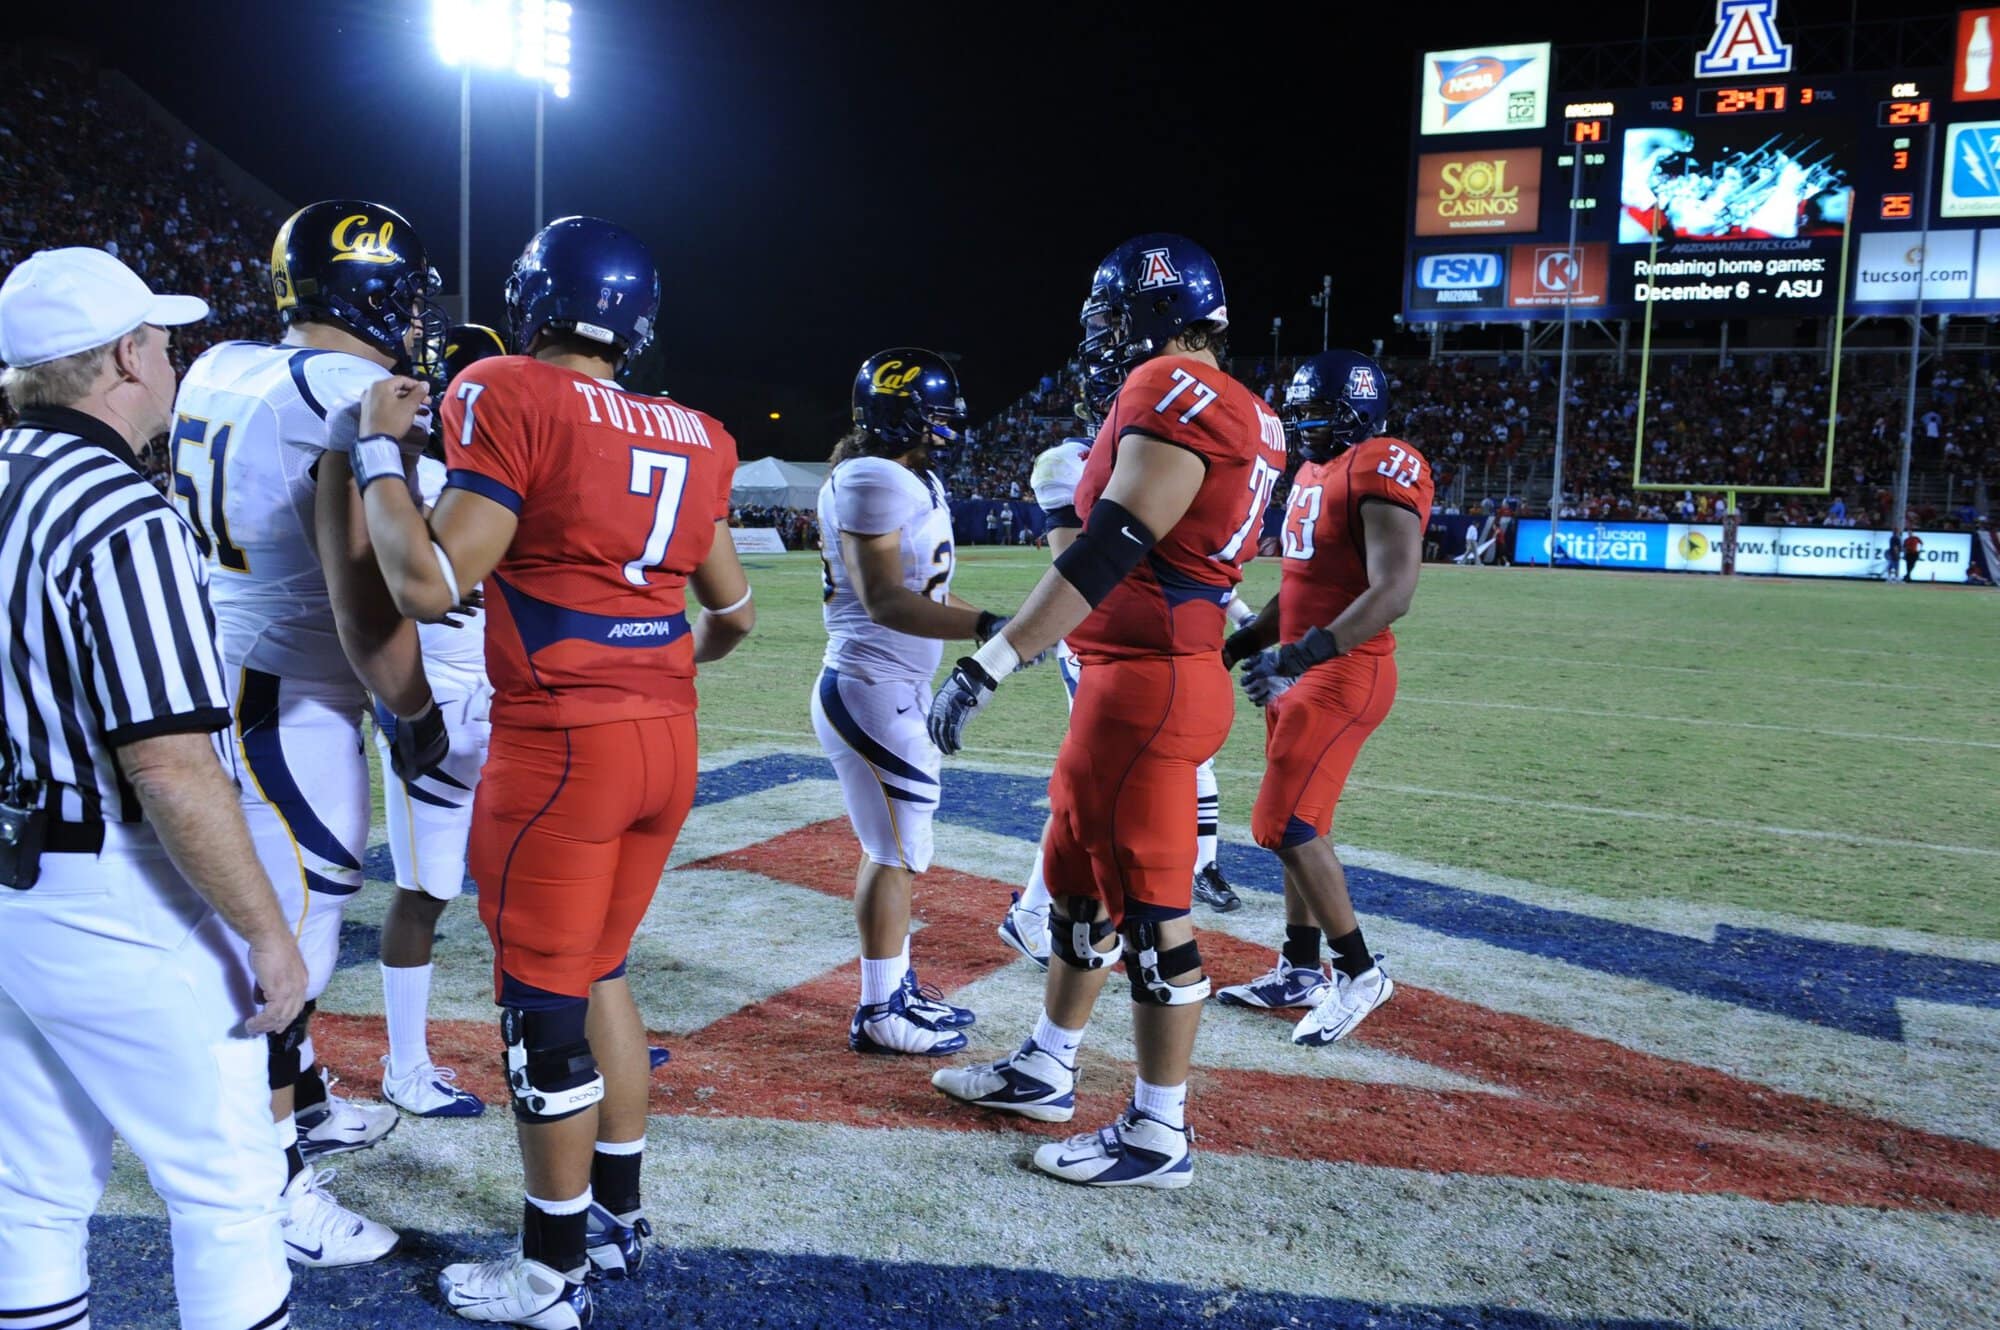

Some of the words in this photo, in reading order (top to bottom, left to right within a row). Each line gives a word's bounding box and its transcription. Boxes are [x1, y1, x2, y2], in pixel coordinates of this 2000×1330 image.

[1694, 0, 1793, 78] A
[1671, 96, 1684, 112] 3
[1716, 86, 1785, 113] 2:47
[1800, 88, 1813, 104] 3
[1889, 101, 1931, 124] 24
[1893, 151, 1908, 170] 3
[1439, 160, 1519, 200] SOL
[1438, 198, 1519, 217] CASINOS
[331, 214, 400, 264] Cal
[1137, 247, 1185, 292] A
[1430, 257, 1489, 284] FSN
[1546, 256, 1574, 286] K
[1718, 259, 1763, 275] home
[1765, 258, 1825, 276] games:
[1634, 282, 1733, 301] December
[1734, 281, 1750, 299] 6
[1774, 279, 1824, 299] ASU
[872, 360, 921, 396] Cal
[1350, 366, 1378, 400] A
[1154, 367, 1219, 425] 77
[456, 381, 487, 447] 7
[573, 380, 712, 449] TUITAMA
[1376, 443, 1422, 489] 33
[170, 411, 252, 576] 51
[623, 446, 689, 586] 7
[1543, 532, 1648, 562] Citizen
[1595, 527, 1648, 542] Tucson
[607, 621, 670, 639] ARIZONA
